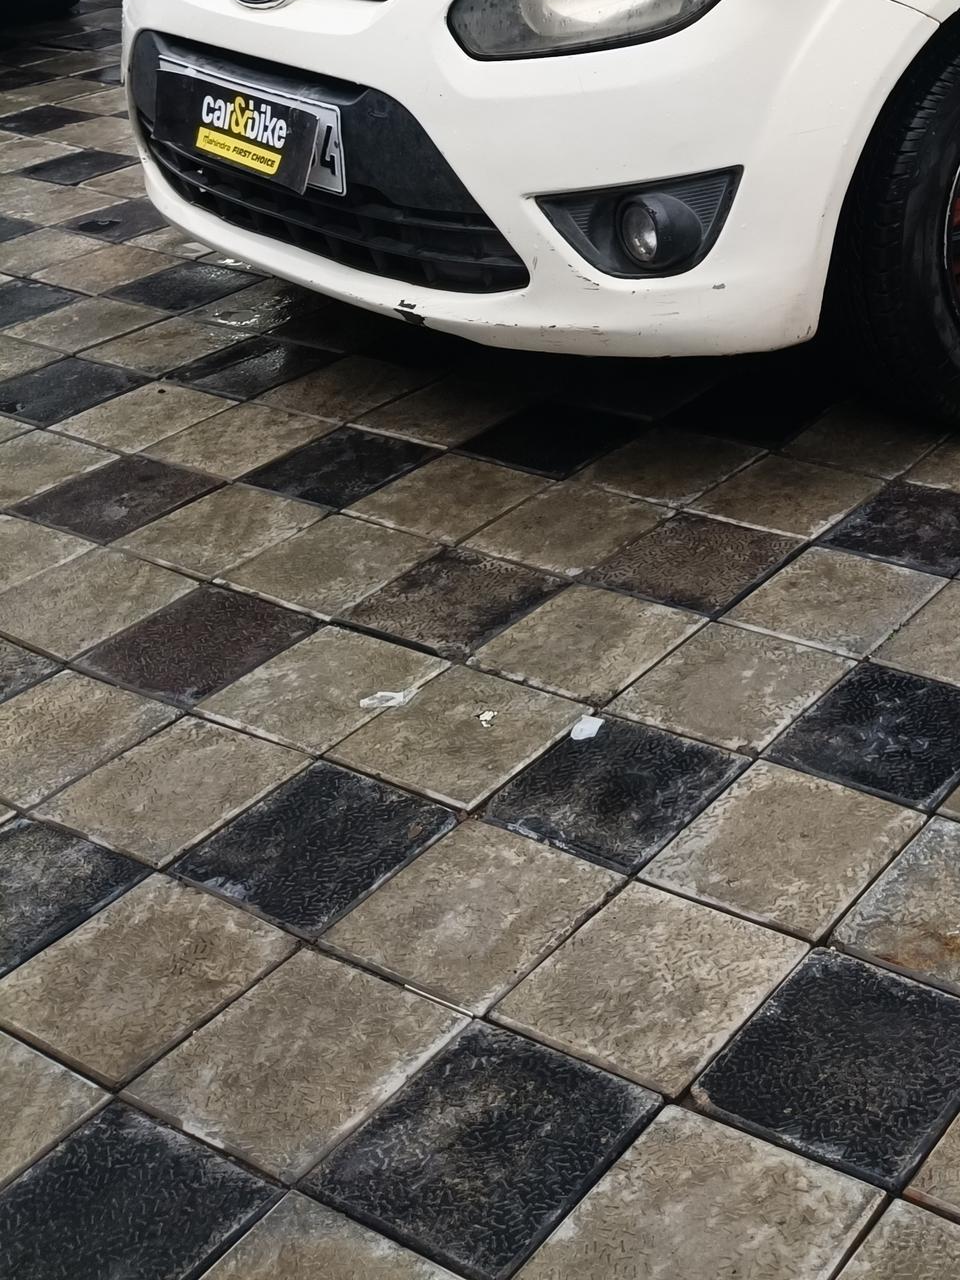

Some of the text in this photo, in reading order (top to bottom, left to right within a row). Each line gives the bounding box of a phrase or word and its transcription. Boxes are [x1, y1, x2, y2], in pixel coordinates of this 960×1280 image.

[201, 95, 287, 149] car&bike
[202, 134, 276, 168] Mahindra FIRST CHOICE
